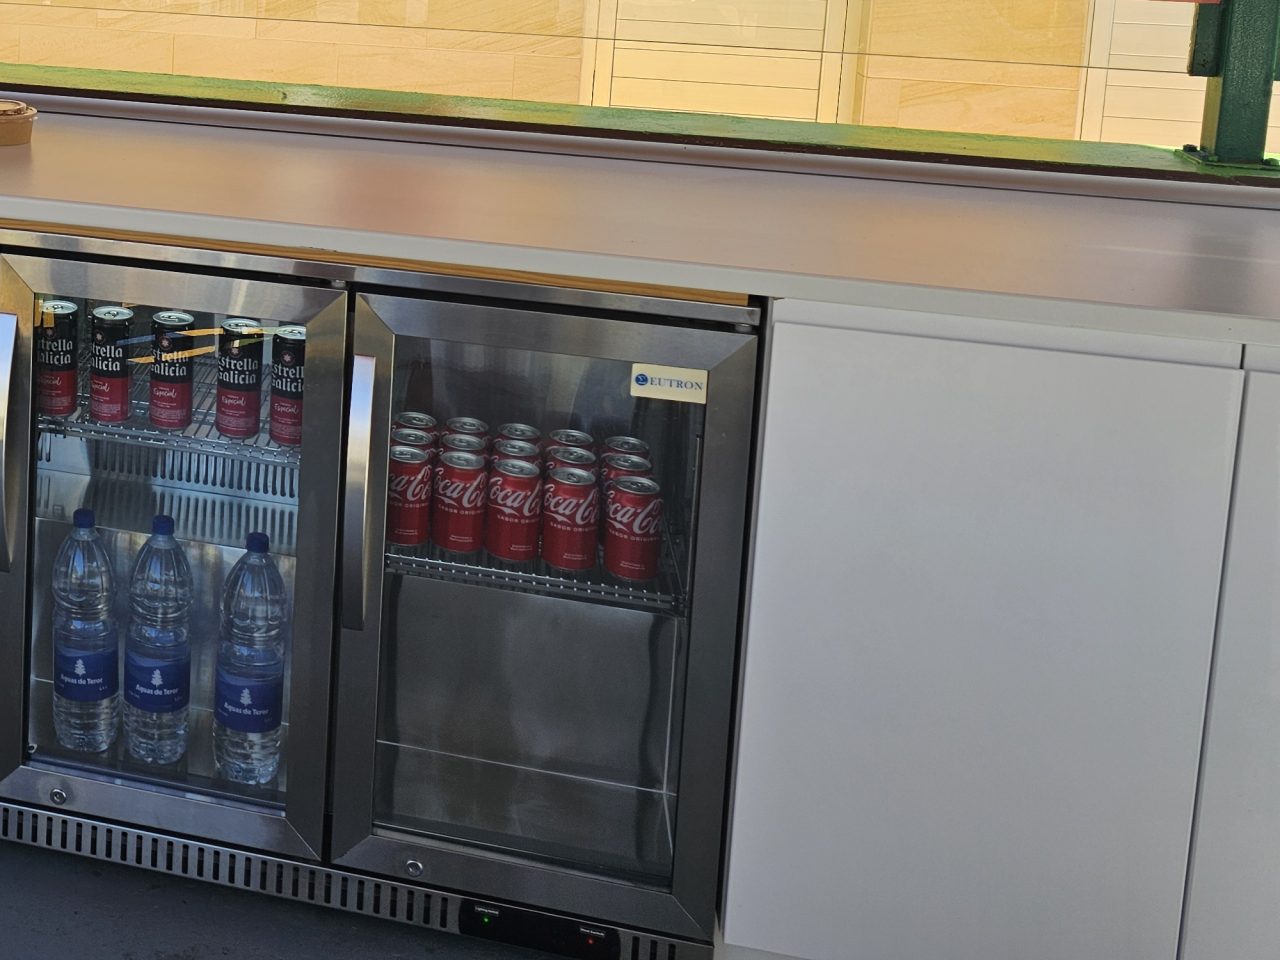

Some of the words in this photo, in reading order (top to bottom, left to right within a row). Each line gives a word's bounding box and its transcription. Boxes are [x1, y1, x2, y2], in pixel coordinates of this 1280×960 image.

[37, 337, 73, 351] trella
[92, 342, 123, 358] trella
[37, 351, 71, 365] alicia
[151, 347, 189, 363] strella
[92, 357, 120, 371] licia
[150, 363, 187, 377] alicia
[272, 361, 304, 378] strell
[272, 374, 304, 392] alici
